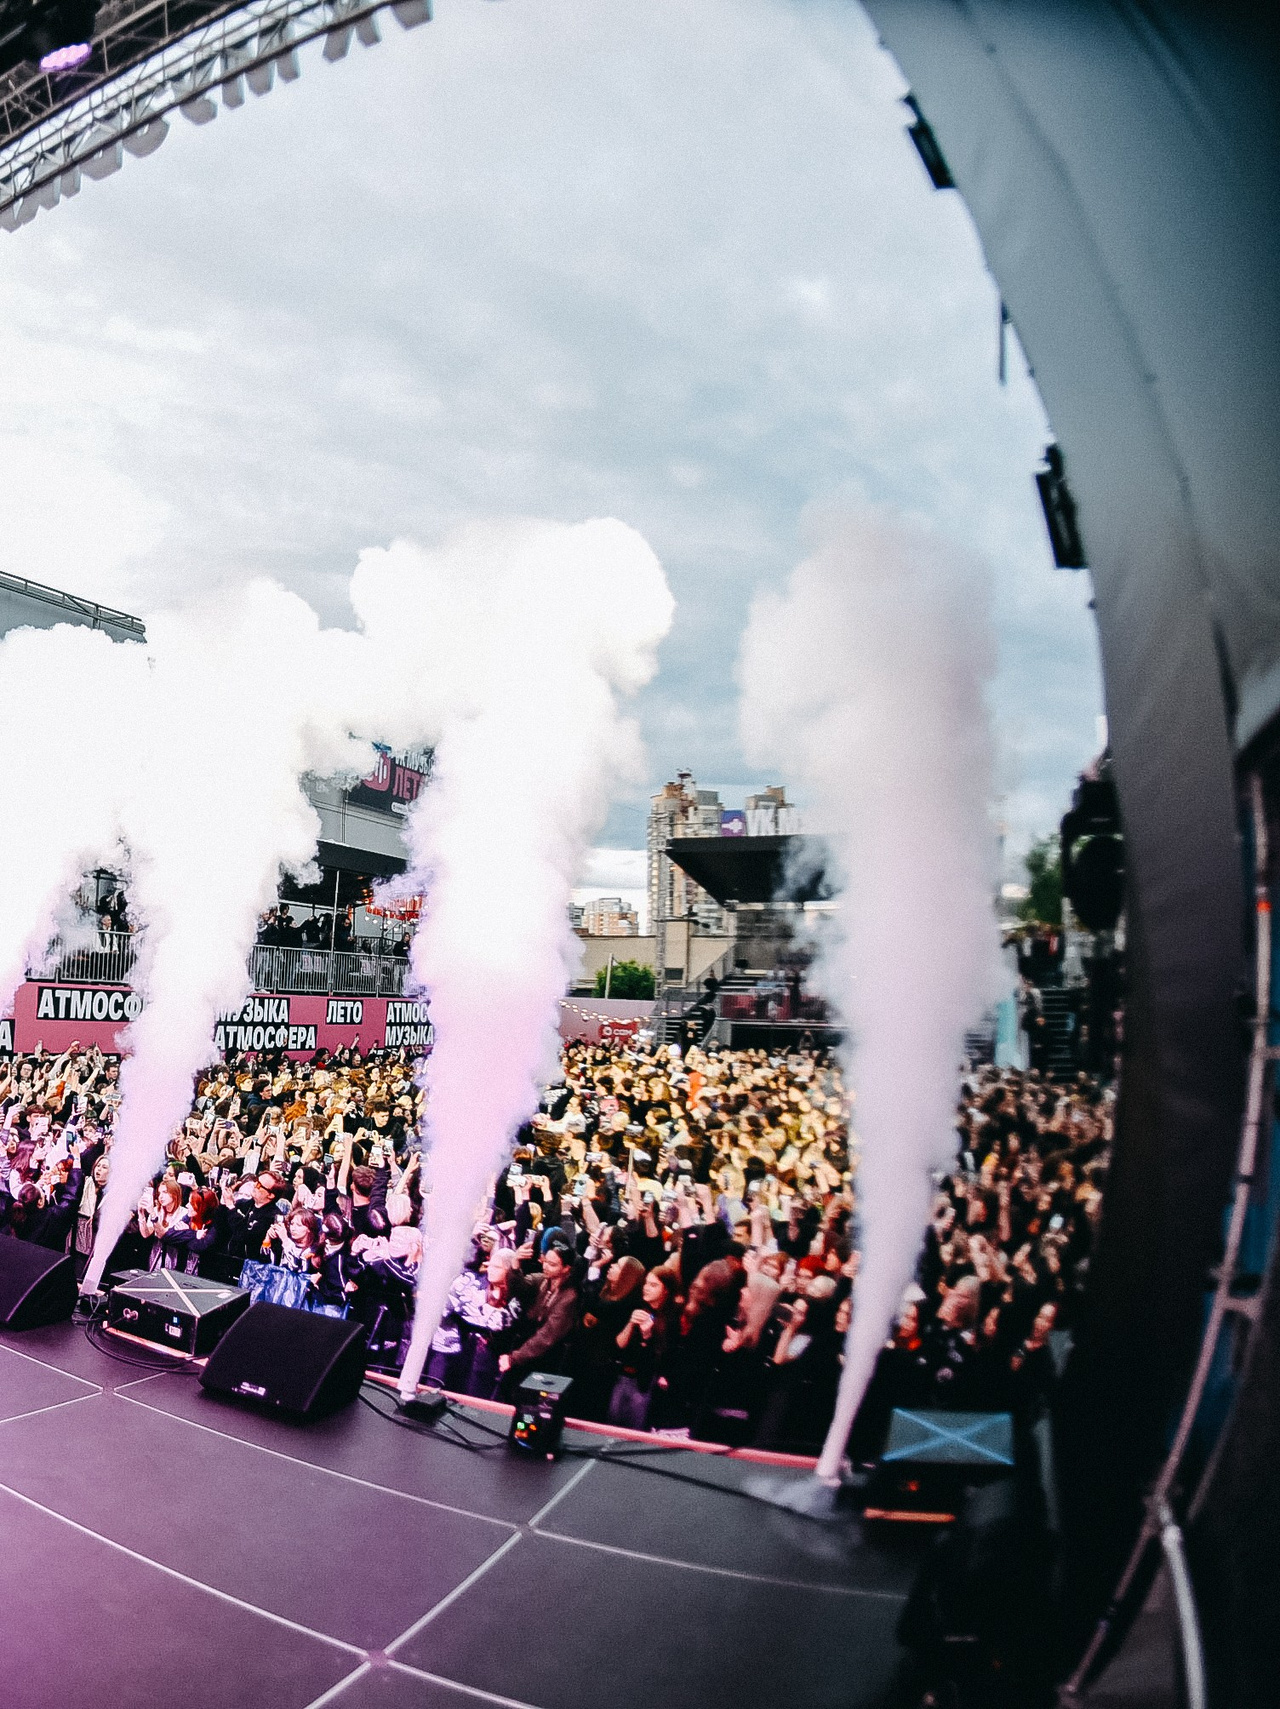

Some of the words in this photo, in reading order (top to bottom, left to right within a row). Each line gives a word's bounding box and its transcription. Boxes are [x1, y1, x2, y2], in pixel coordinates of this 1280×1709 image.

[392, 766, 422, 800] ЛЕТ
[37, 988, 146, 1022] АТМОСФ
[326, 1000, 363, 1024] ЛЕТО
[385, 1002, 428, 1023] АТМОС
[215, 1025, 316, 1051] АТМОСФЕРА
[384, 1025, 434, 1047] МУЗЫКА
